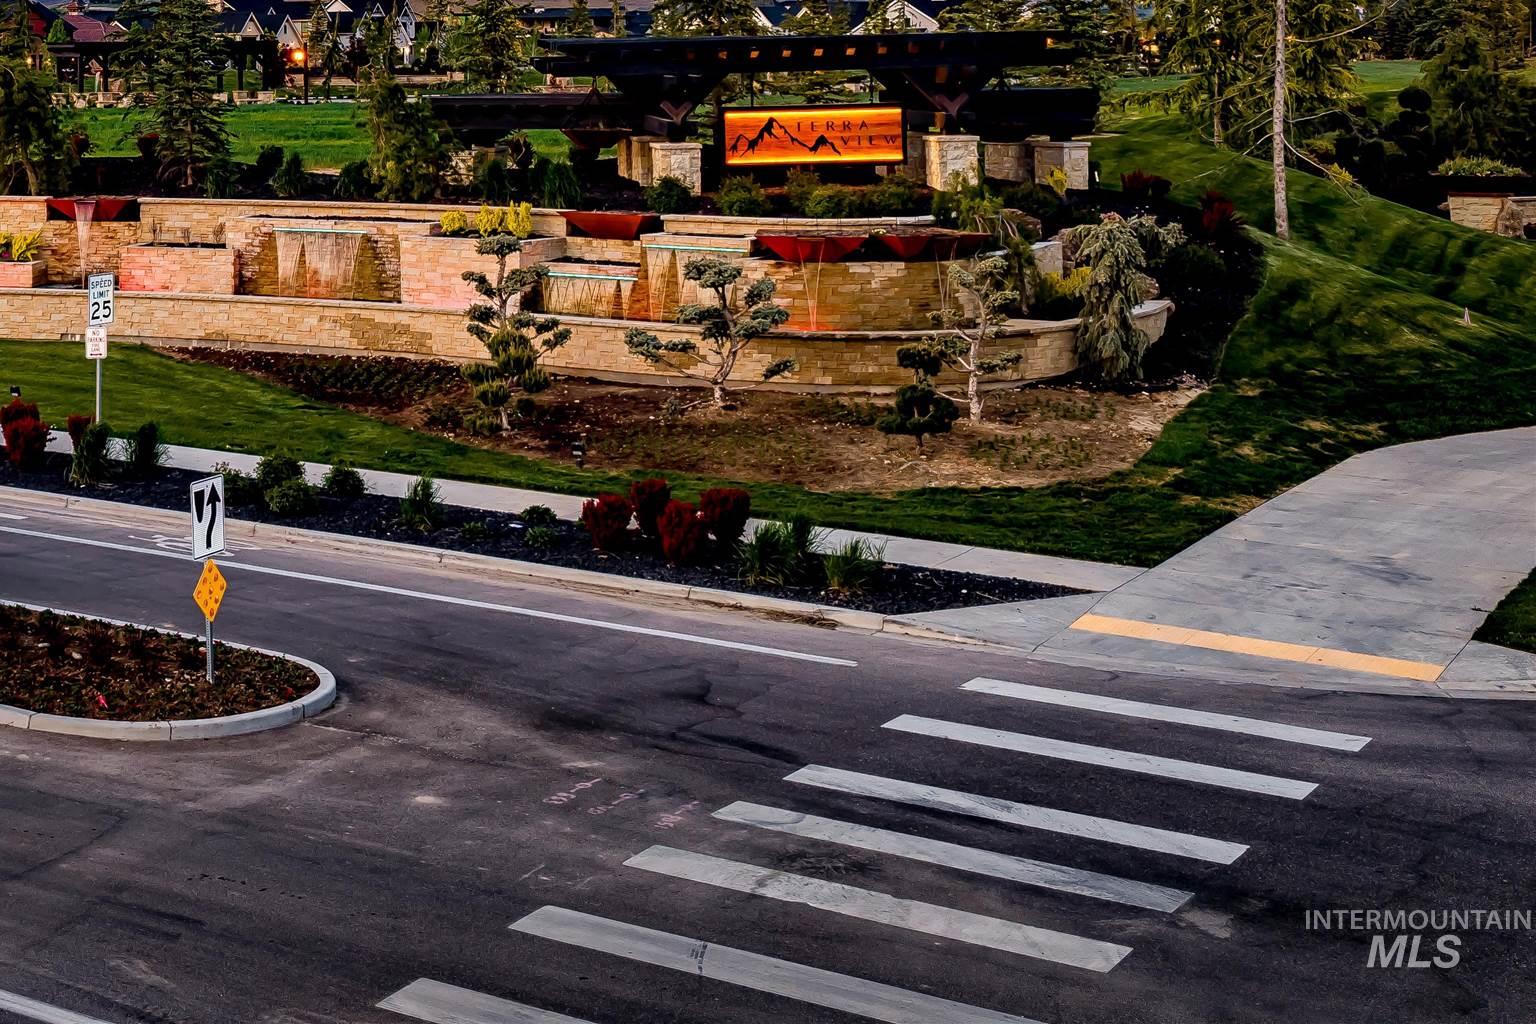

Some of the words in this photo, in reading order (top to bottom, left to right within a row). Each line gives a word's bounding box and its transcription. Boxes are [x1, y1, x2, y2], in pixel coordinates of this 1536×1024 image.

[796, 120, 869, 132] TERRA
[840, 135, 898, 146] VIEW
[91, 279, 112, 290] SPEED
[93, 290, 110, 299] LIMIT
[91, 300, 112, 320] 25
